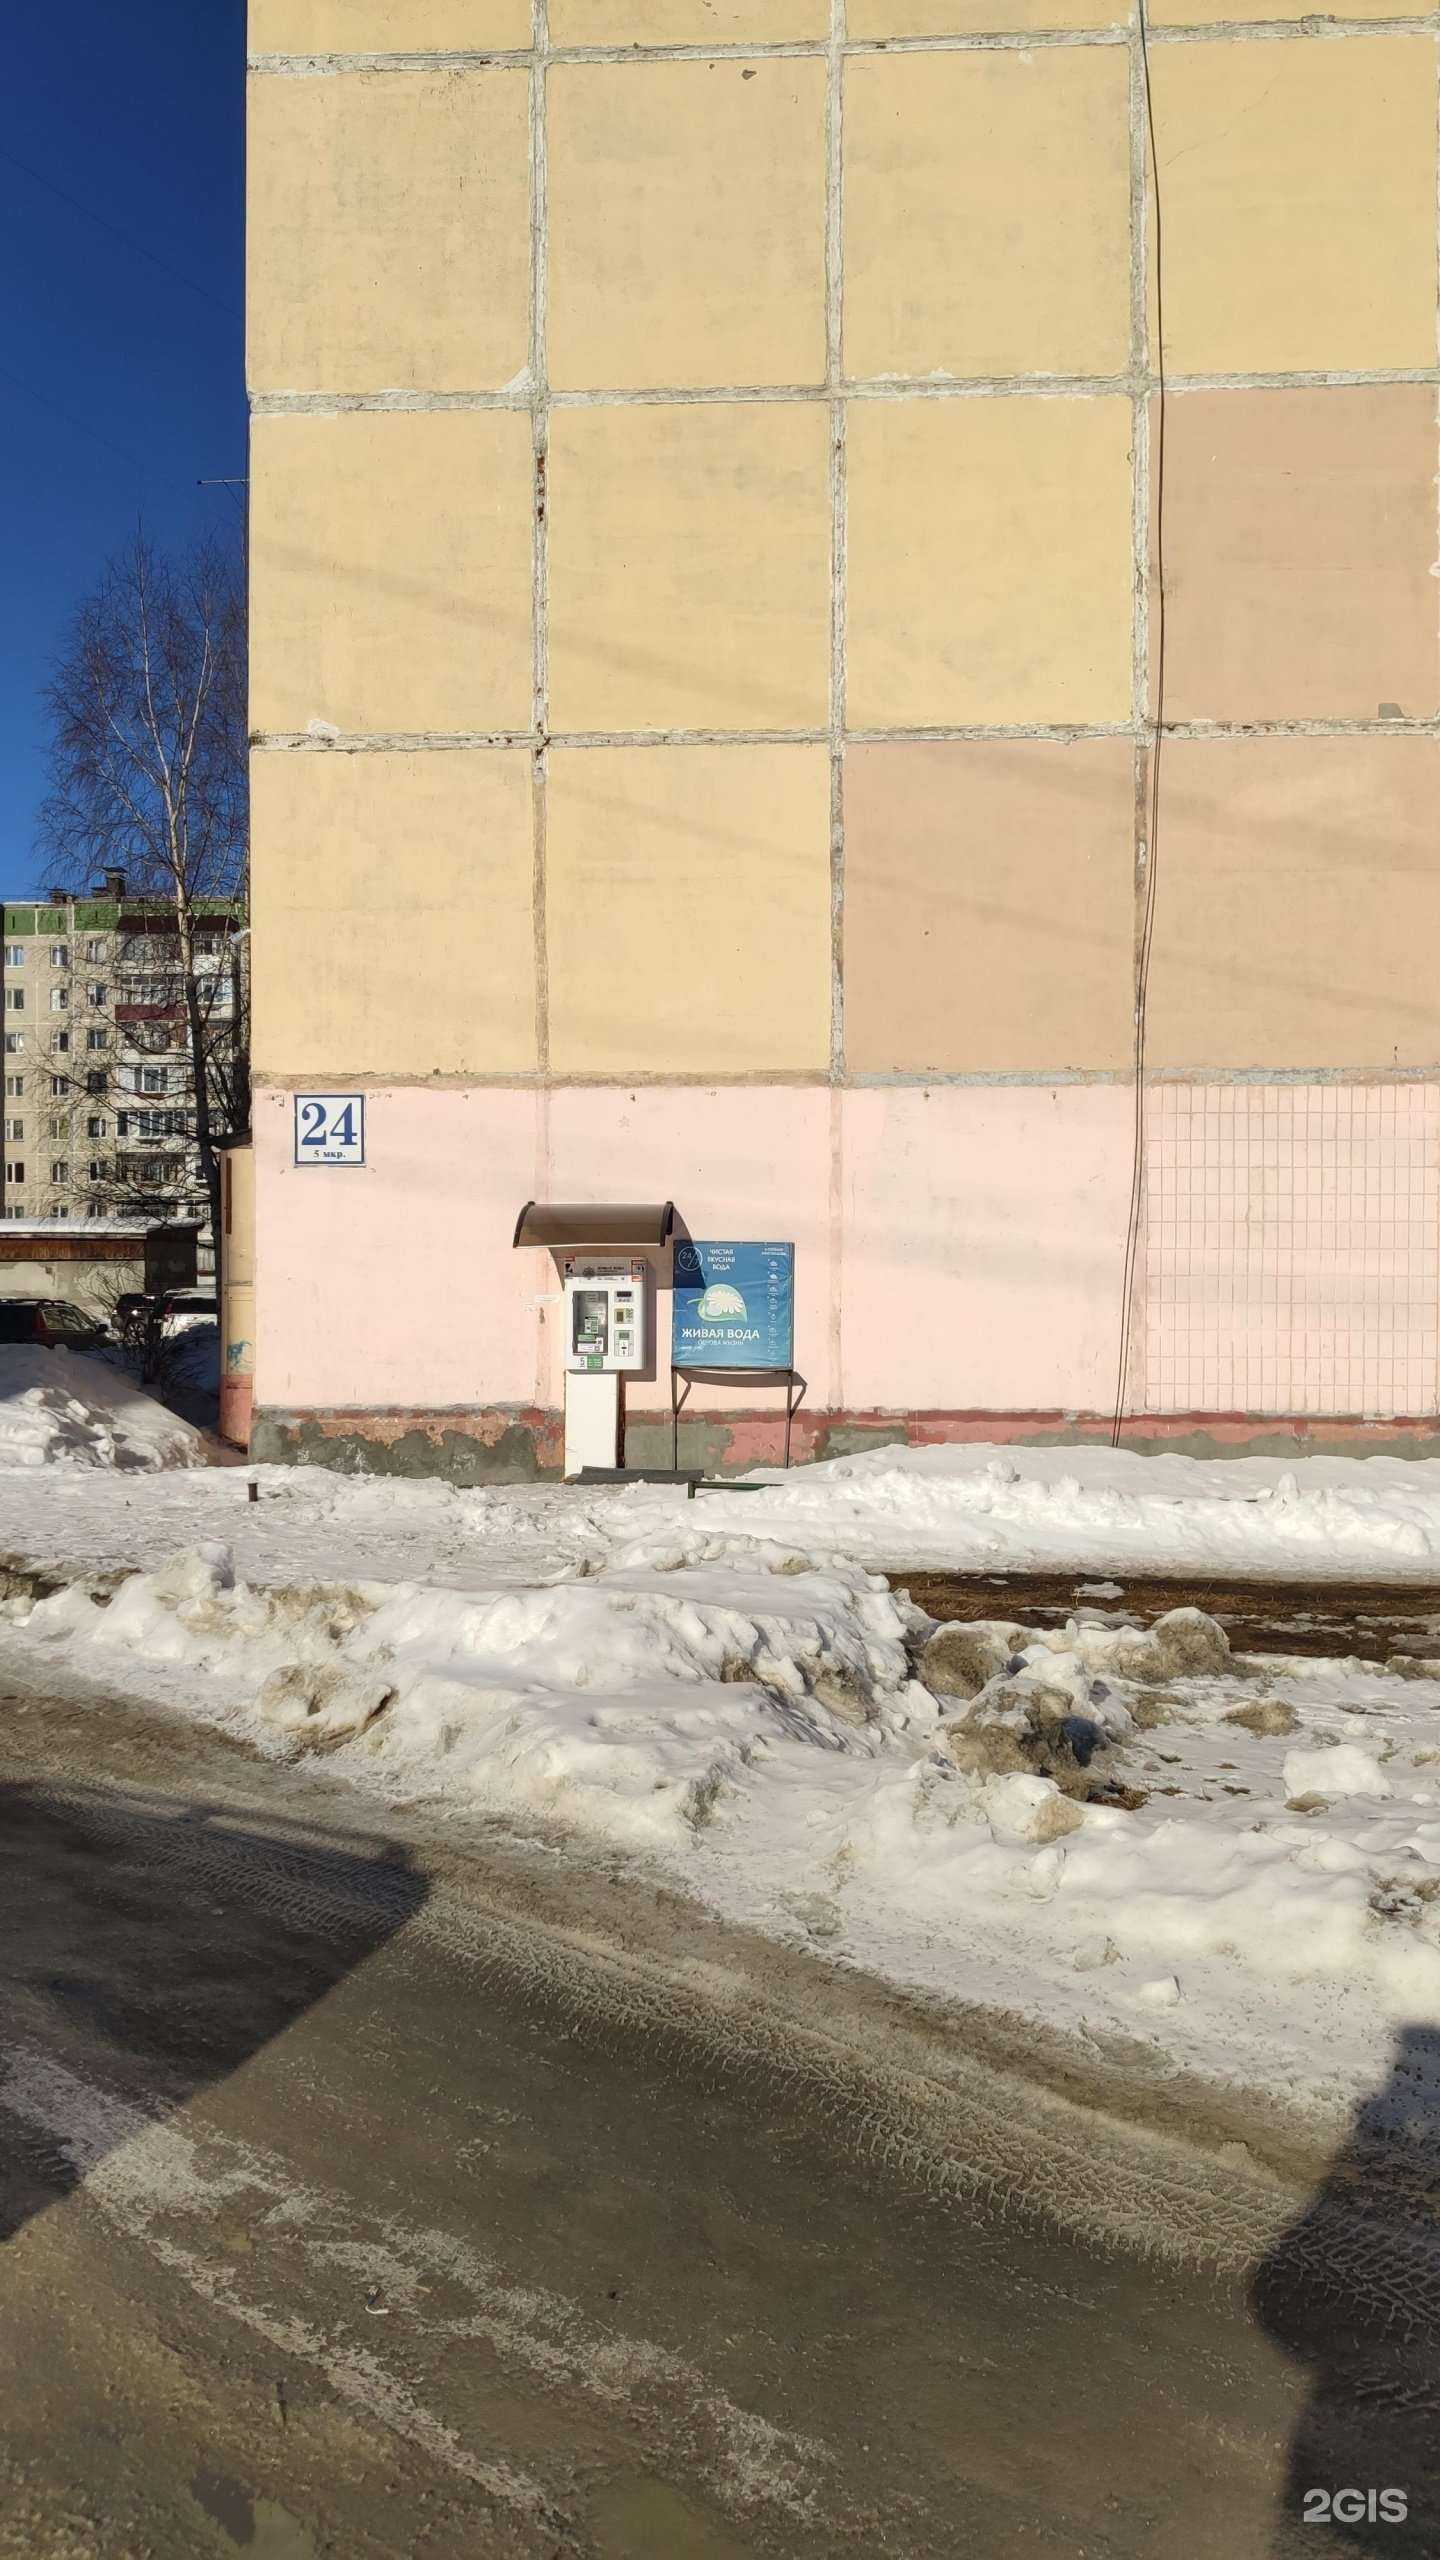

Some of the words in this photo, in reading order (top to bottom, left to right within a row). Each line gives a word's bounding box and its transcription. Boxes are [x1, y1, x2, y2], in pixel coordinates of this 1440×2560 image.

[301, 1102, 358, 1146] 24
[313, 1150, 320, 1158] 5
[323, 1151, 346, 1159] мкр.
[681, 1328, 724, 1338] ЖИВАЯ
[727, 1329, 760, 1341] ВОДА
